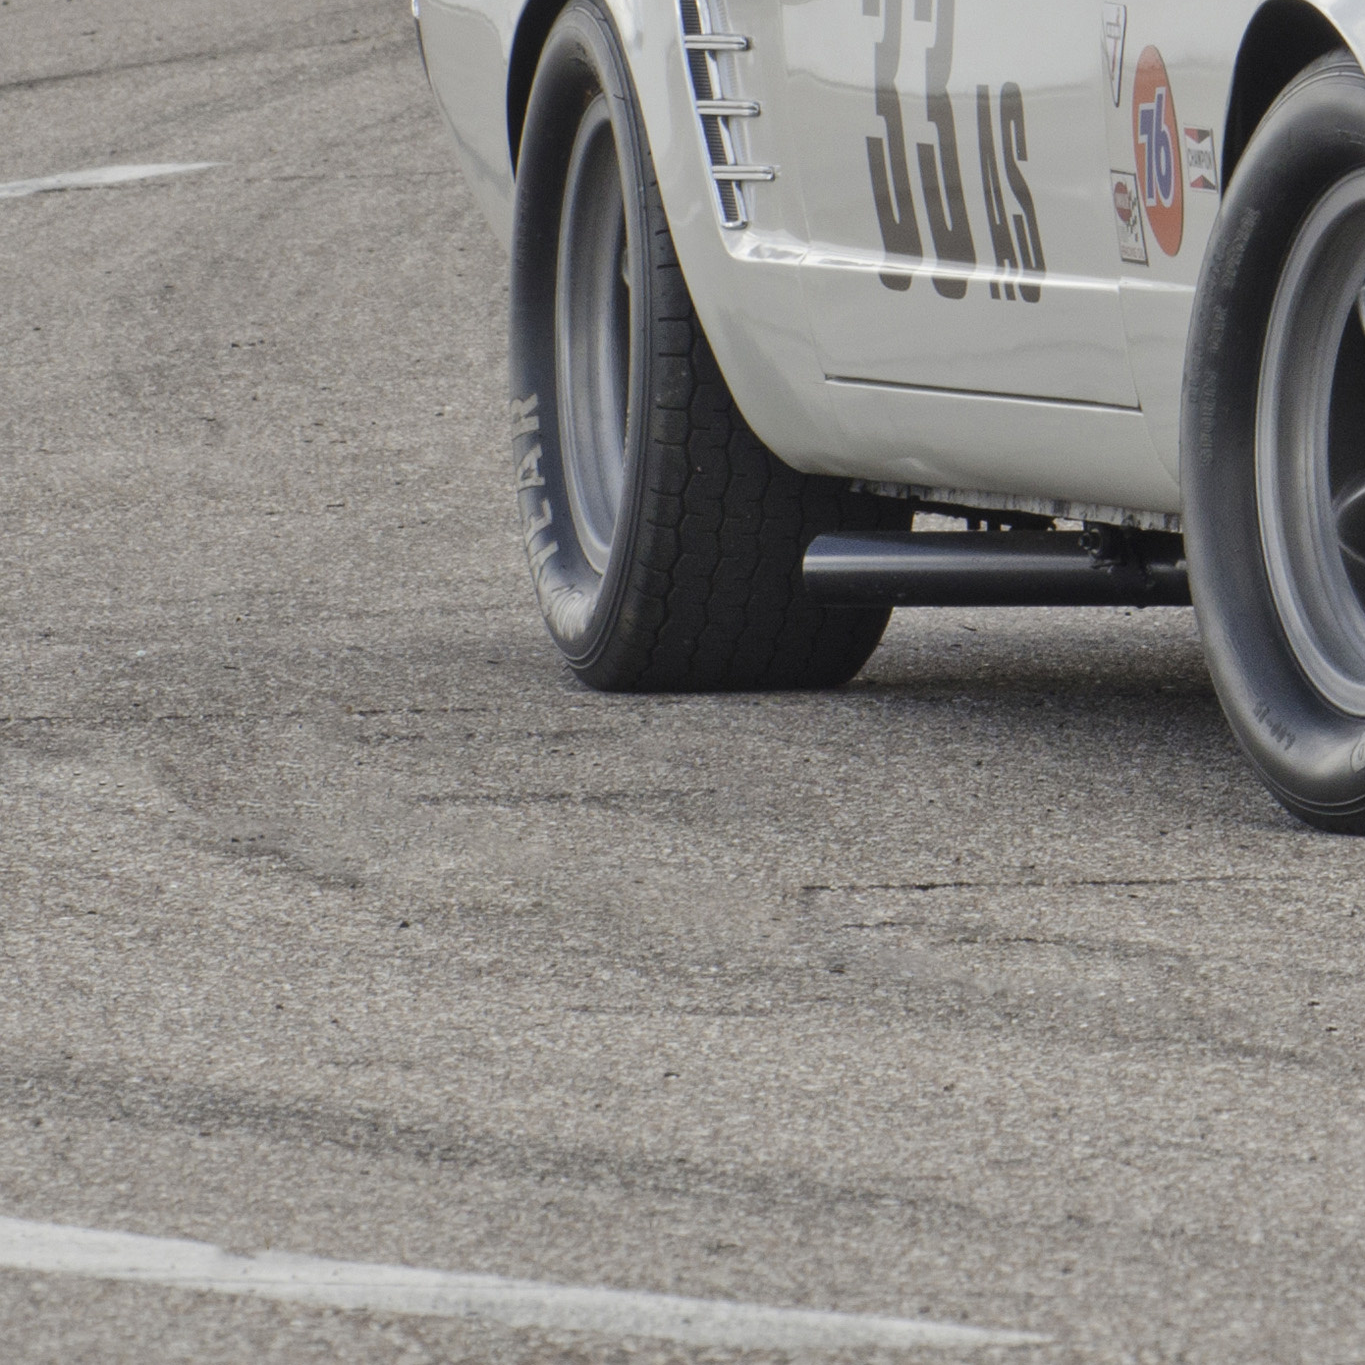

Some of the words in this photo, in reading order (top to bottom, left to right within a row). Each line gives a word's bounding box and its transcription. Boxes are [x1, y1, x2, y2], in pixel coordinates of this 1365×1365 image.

[976, 81, 1046, 303] AS
[1138, 87, 1177, 208] 76
[1187, 148, 1213, 171] CHAMPION
